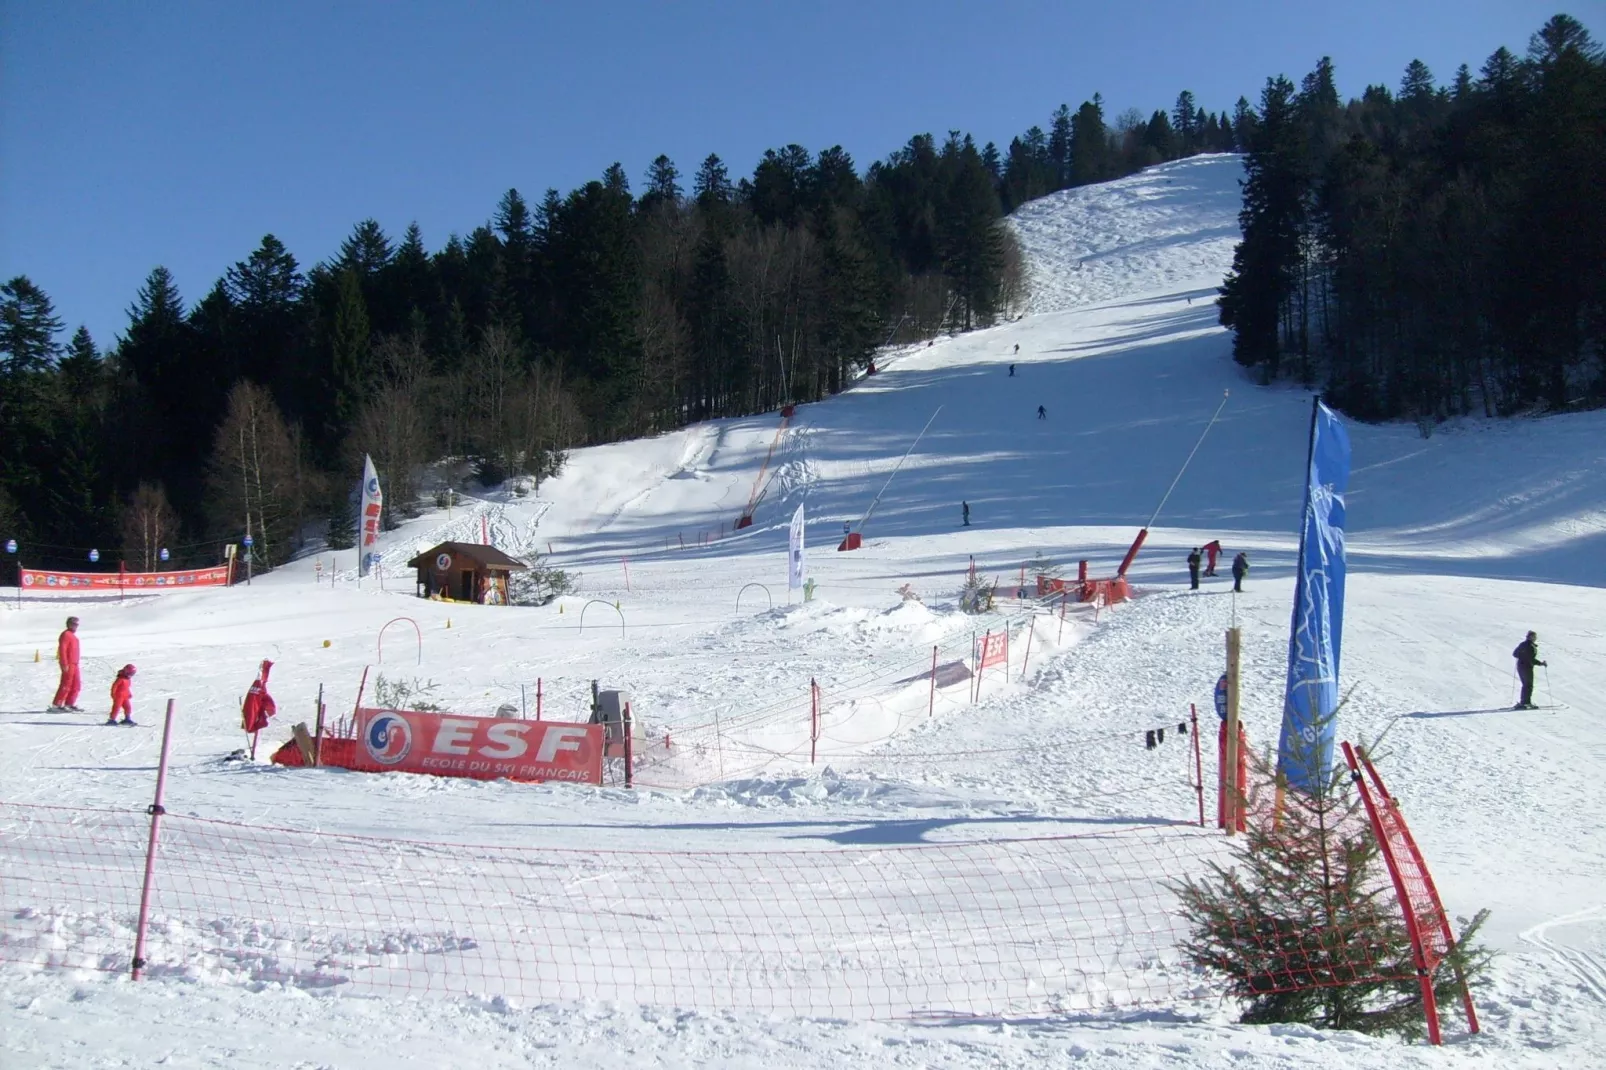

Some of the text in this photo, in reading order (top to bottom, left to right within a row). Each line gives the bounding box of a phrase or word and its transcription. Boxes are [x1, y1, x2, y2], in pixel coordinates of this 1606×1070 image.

[431, 718, 588, 763] ESF
[422, 757, 465, 770] ECOLE
[469, 760, 490, 771] DU
[494, 763, 515, 774] SKI
